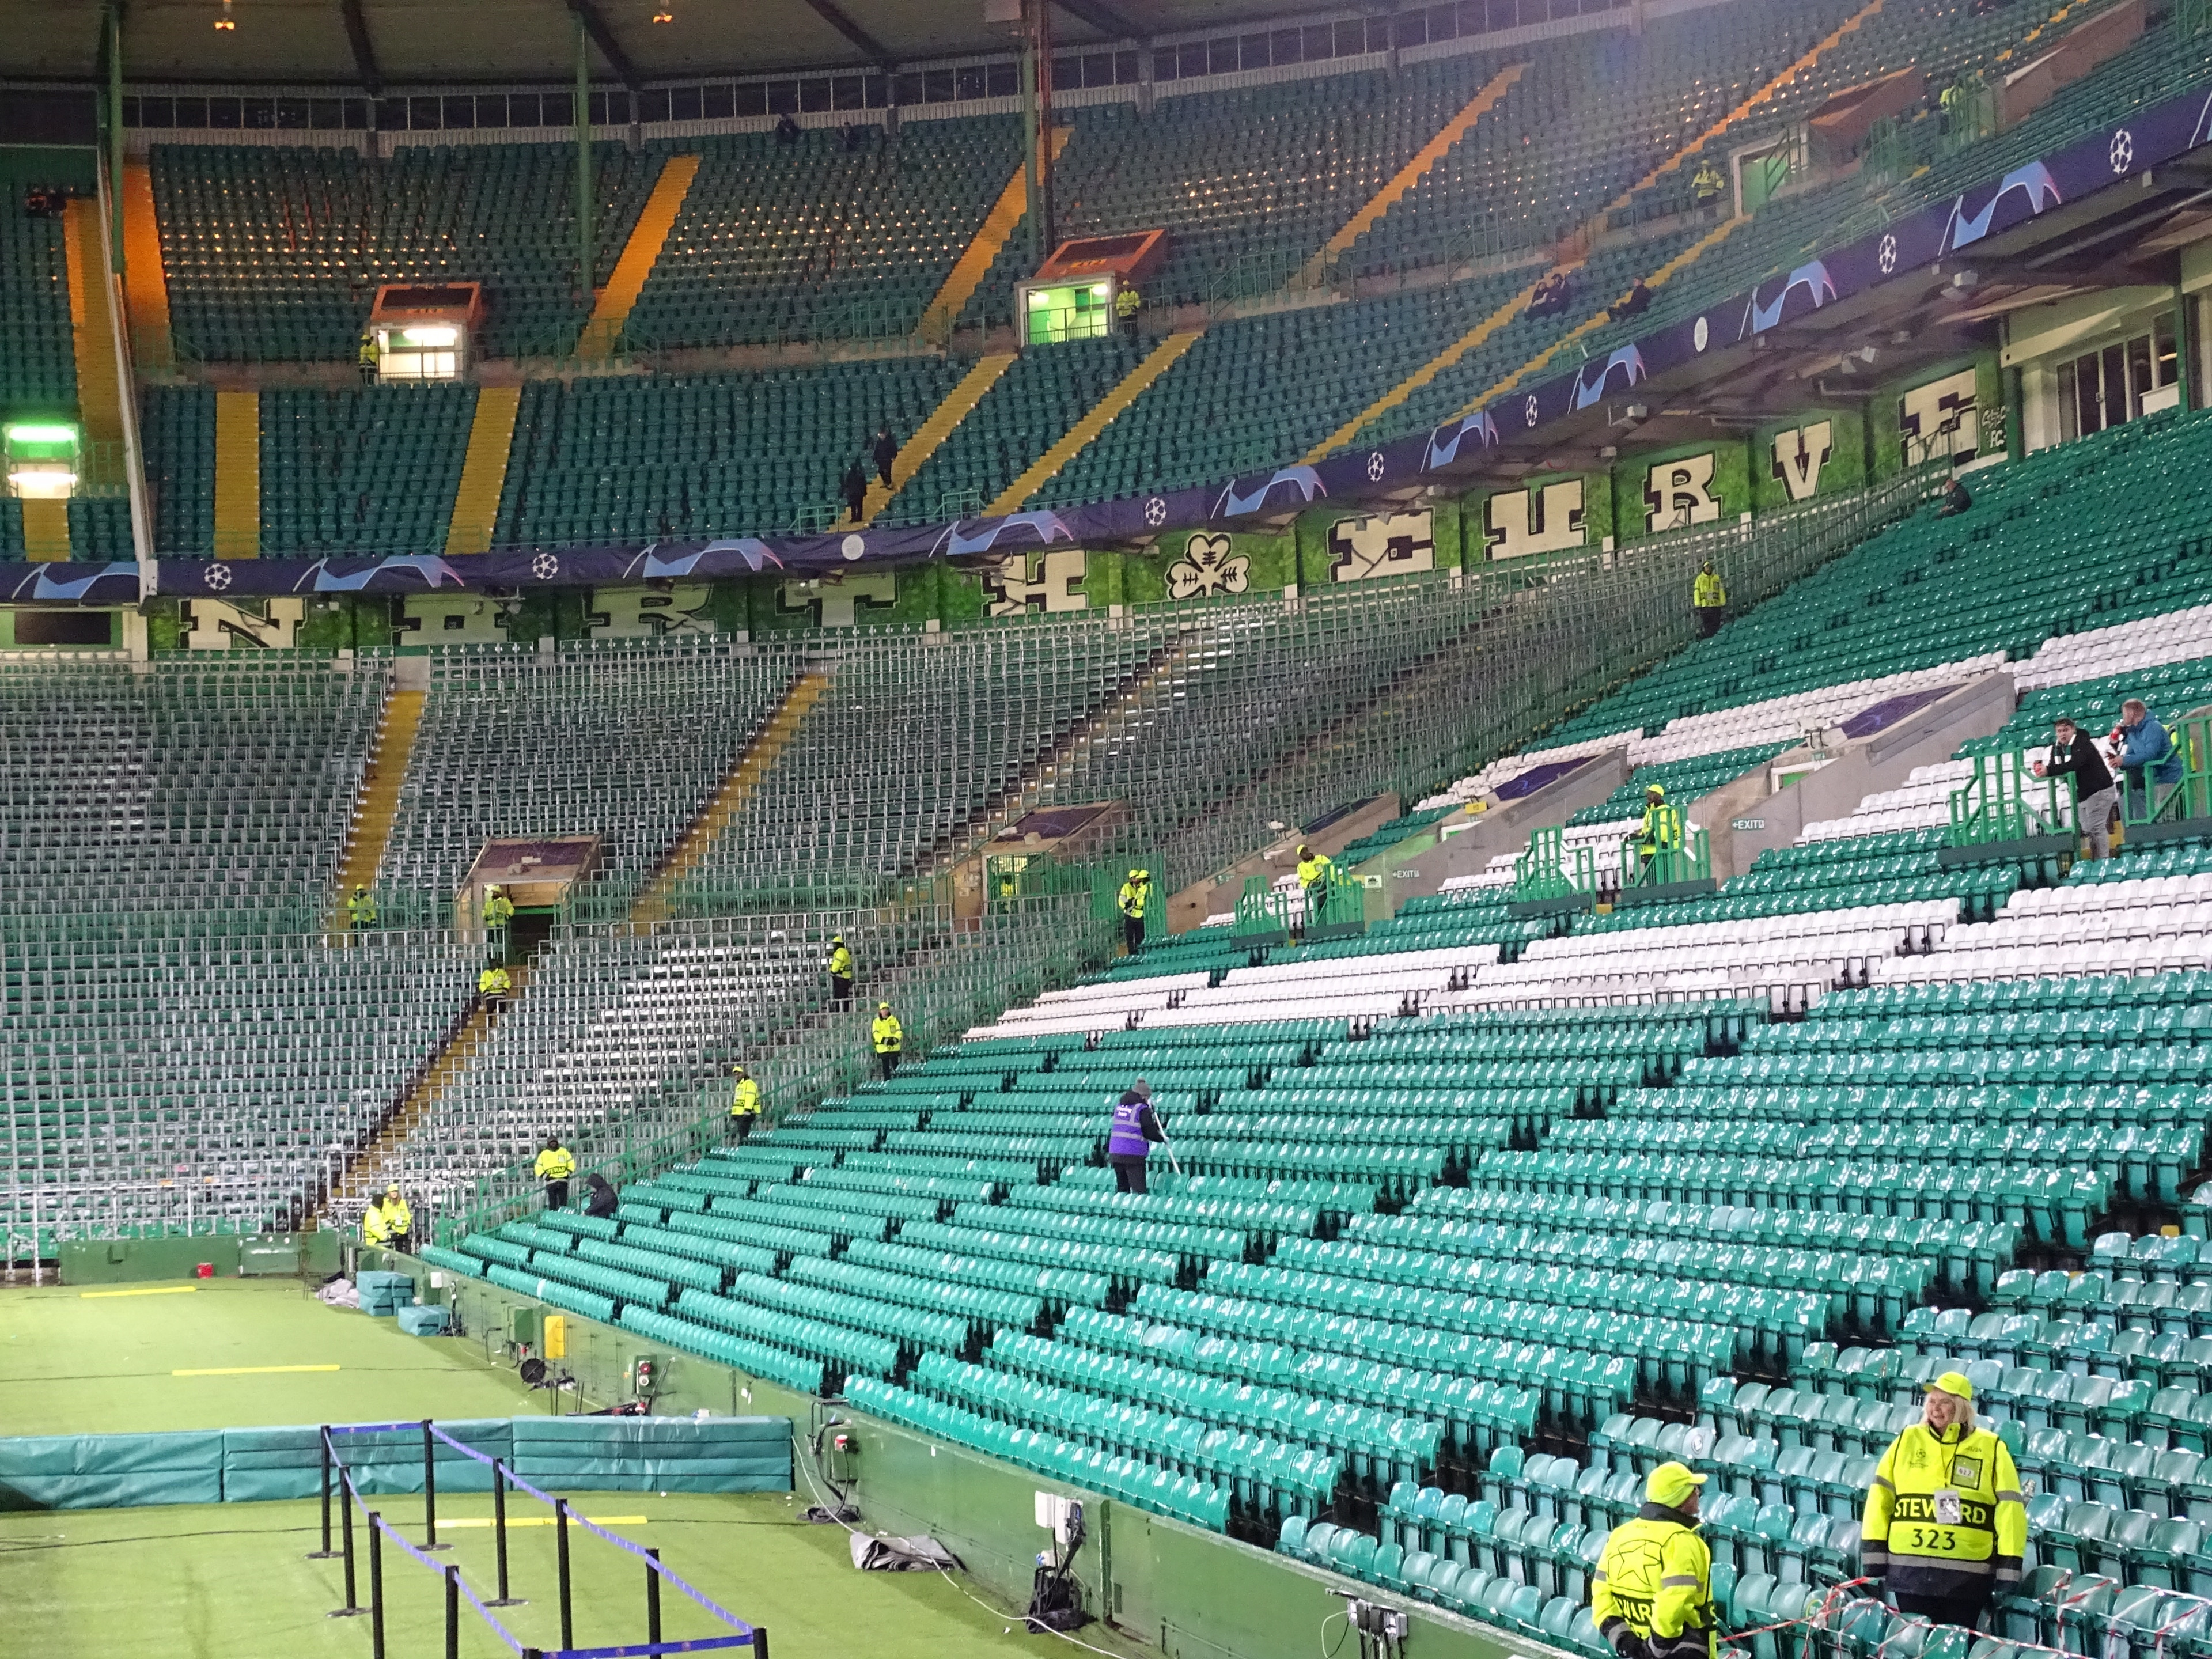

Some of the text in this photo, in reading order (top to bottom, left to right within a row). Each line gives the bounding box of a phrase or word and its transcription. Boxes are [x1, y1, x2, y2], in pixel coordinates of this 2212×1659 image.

[179, 368, 1979, 649] NORTH CURVE
[1738, 820, 1759, 830] EXIT
[1397, 870, 1414, 878] EXIT
[1894, 1498, 1986, 1524] STEWRD
[1911, 1528, 1956, 1550] 323
